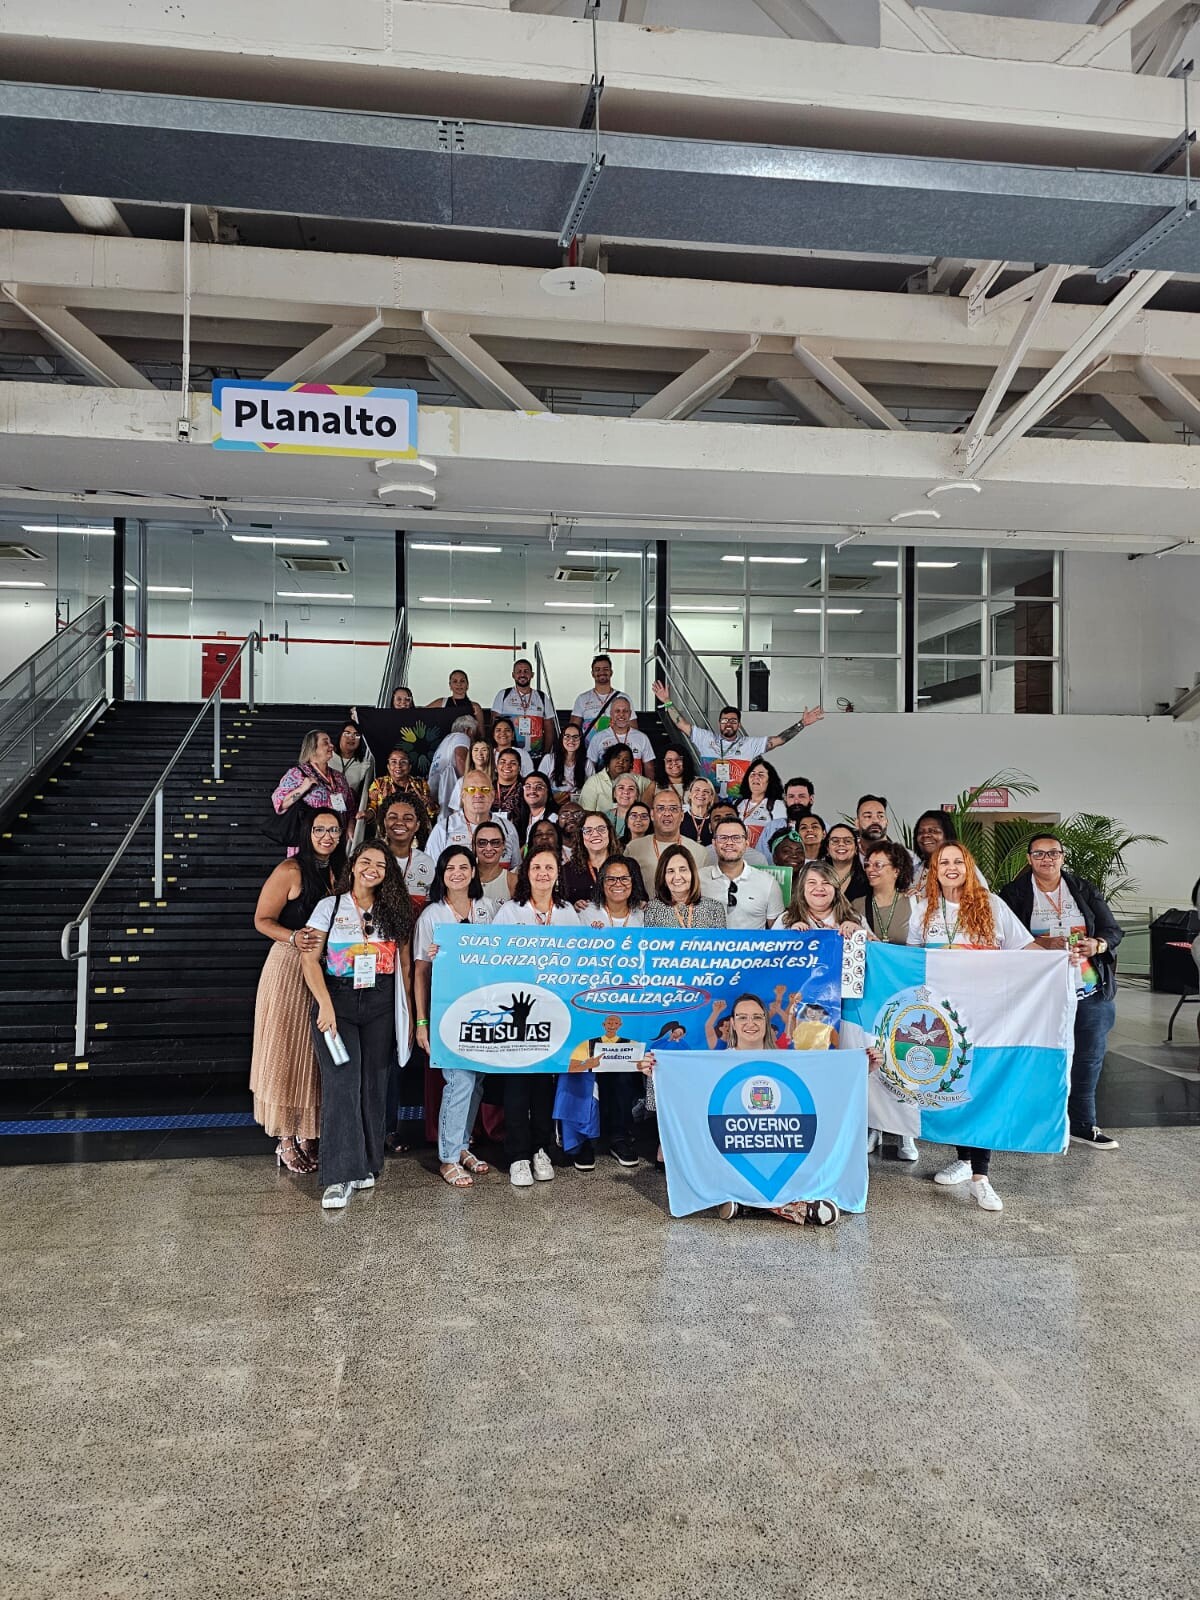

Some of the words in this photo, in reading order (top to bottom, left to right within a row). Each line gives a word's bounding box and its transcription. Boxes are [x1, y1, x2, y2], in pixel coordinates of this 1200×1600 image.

[234, 399, 397, 438] Planalto
[458, 935, 501, 947] SUAS
[506, 936, 615, 950] FORTALECIDO
[621, 935, 633, 950] É
[638, 939, 674, 951] COM
[680, 939, 804, 952] FINANCIAMENTO
[808, 940, 820, 951] E
[459, 953, 571, 970] VALORIZAÇÃO
[651, 954, 819, 969] TRABALHADORAS(ES)!
[536, 971, 623, 989] PROTEÇÃO
[628, 974, 685, 987] SOCIAL
[692, 973, 725, 987] NÃO
[729, 971, 741, 986] É
[584, 990, 701, 1007] FISCALIZAÇÃO!
[725, 1117, 801, 1132] GOVERNO
[724, 1134, 804, 1149] PRESENTE
